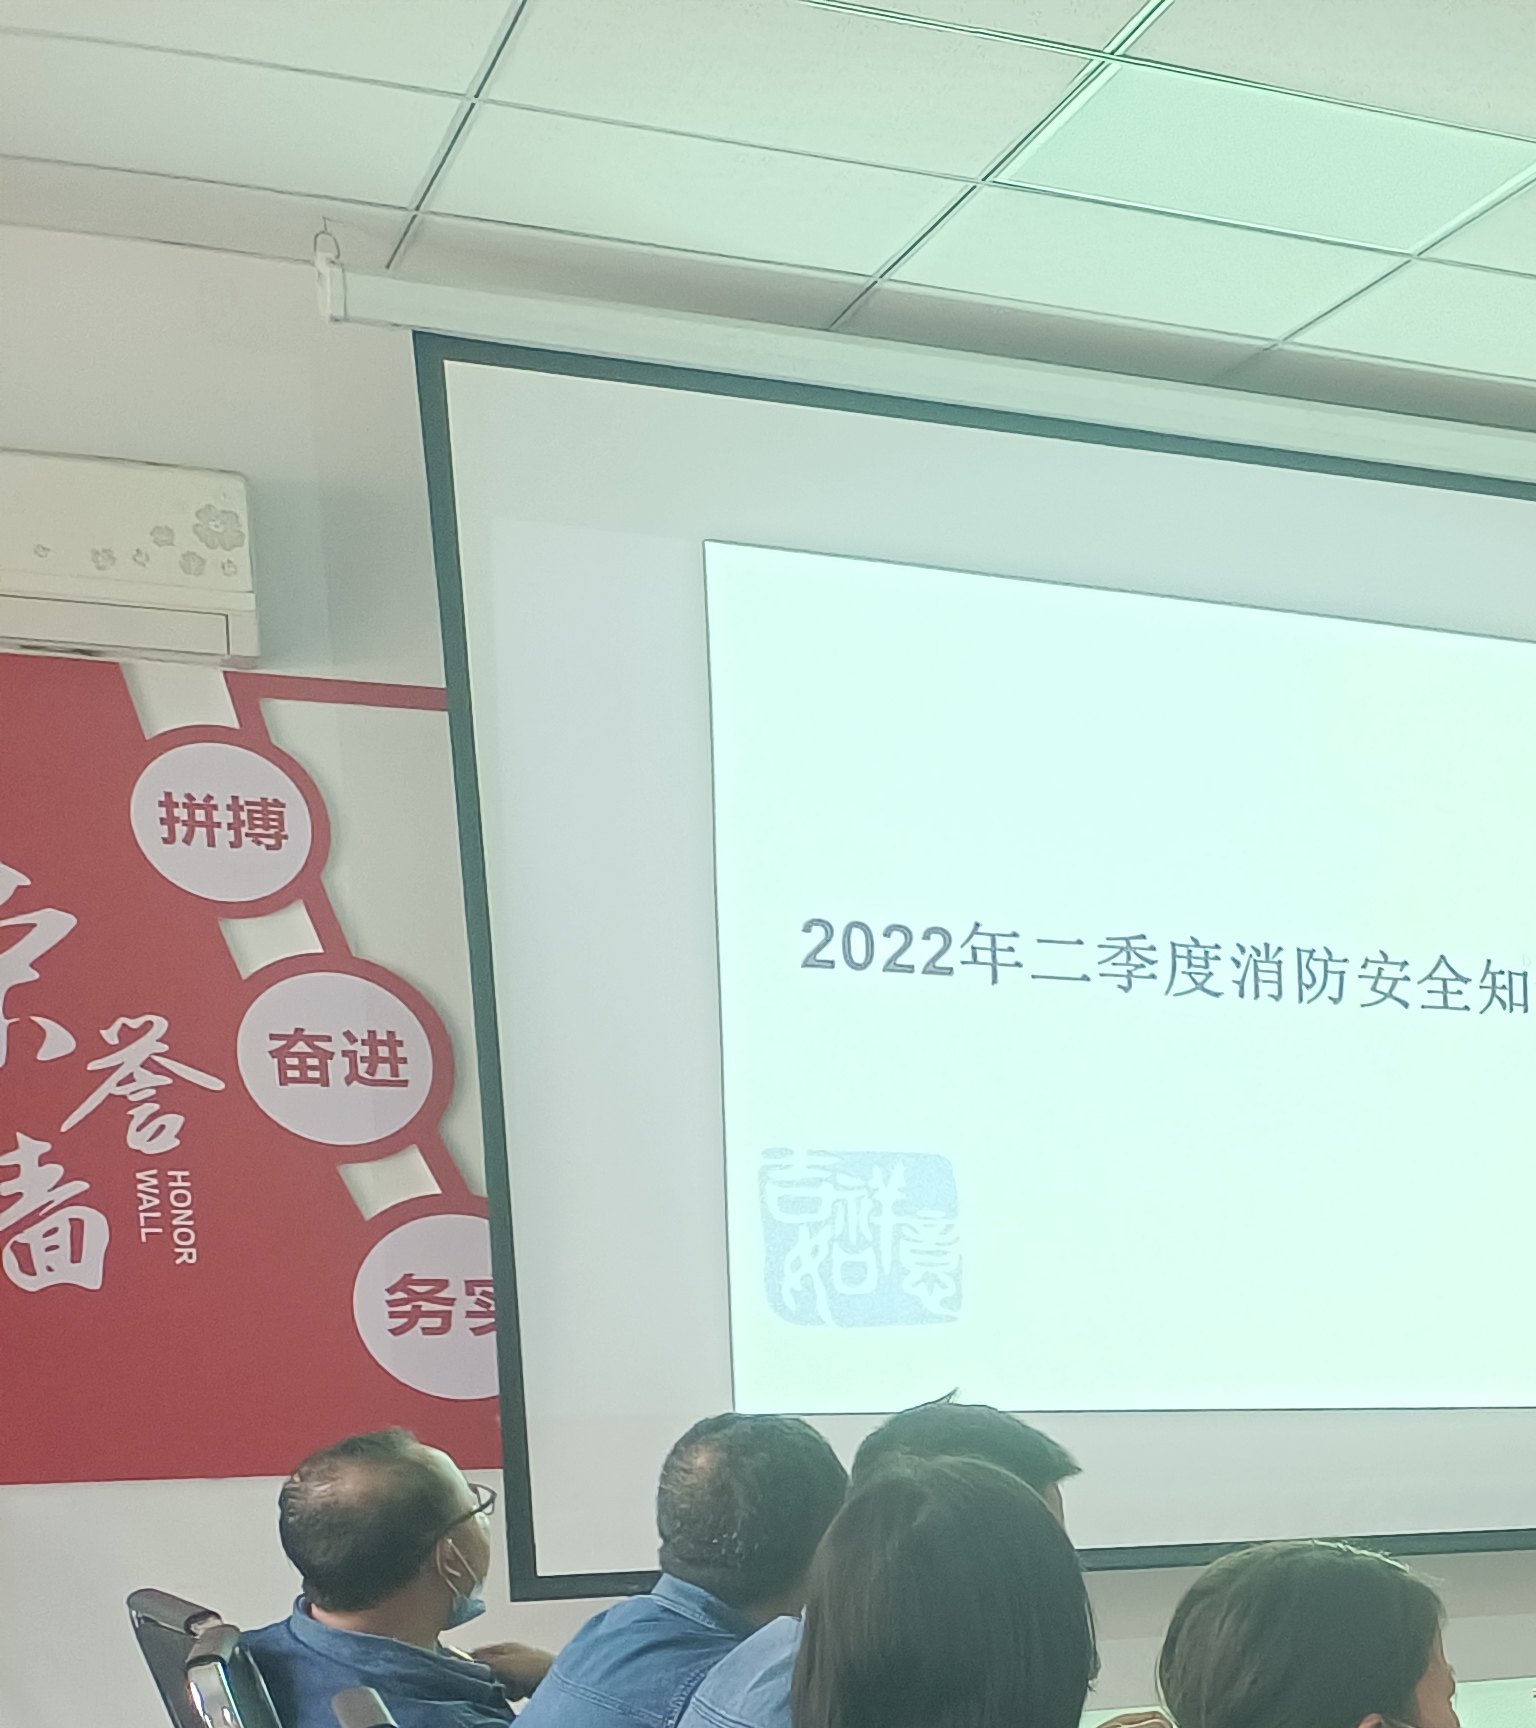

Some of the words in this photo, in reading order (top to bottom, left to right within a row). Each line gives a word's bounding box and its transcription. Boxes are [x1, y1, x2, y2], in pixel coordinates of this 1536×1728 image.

[158, 790, 289, 852] 拼搏
[268, 1027, 410, 1090] 奋进
[134, 1169, 167, 1244] WALL
[166, 1169, 197, 1266] HONOR
